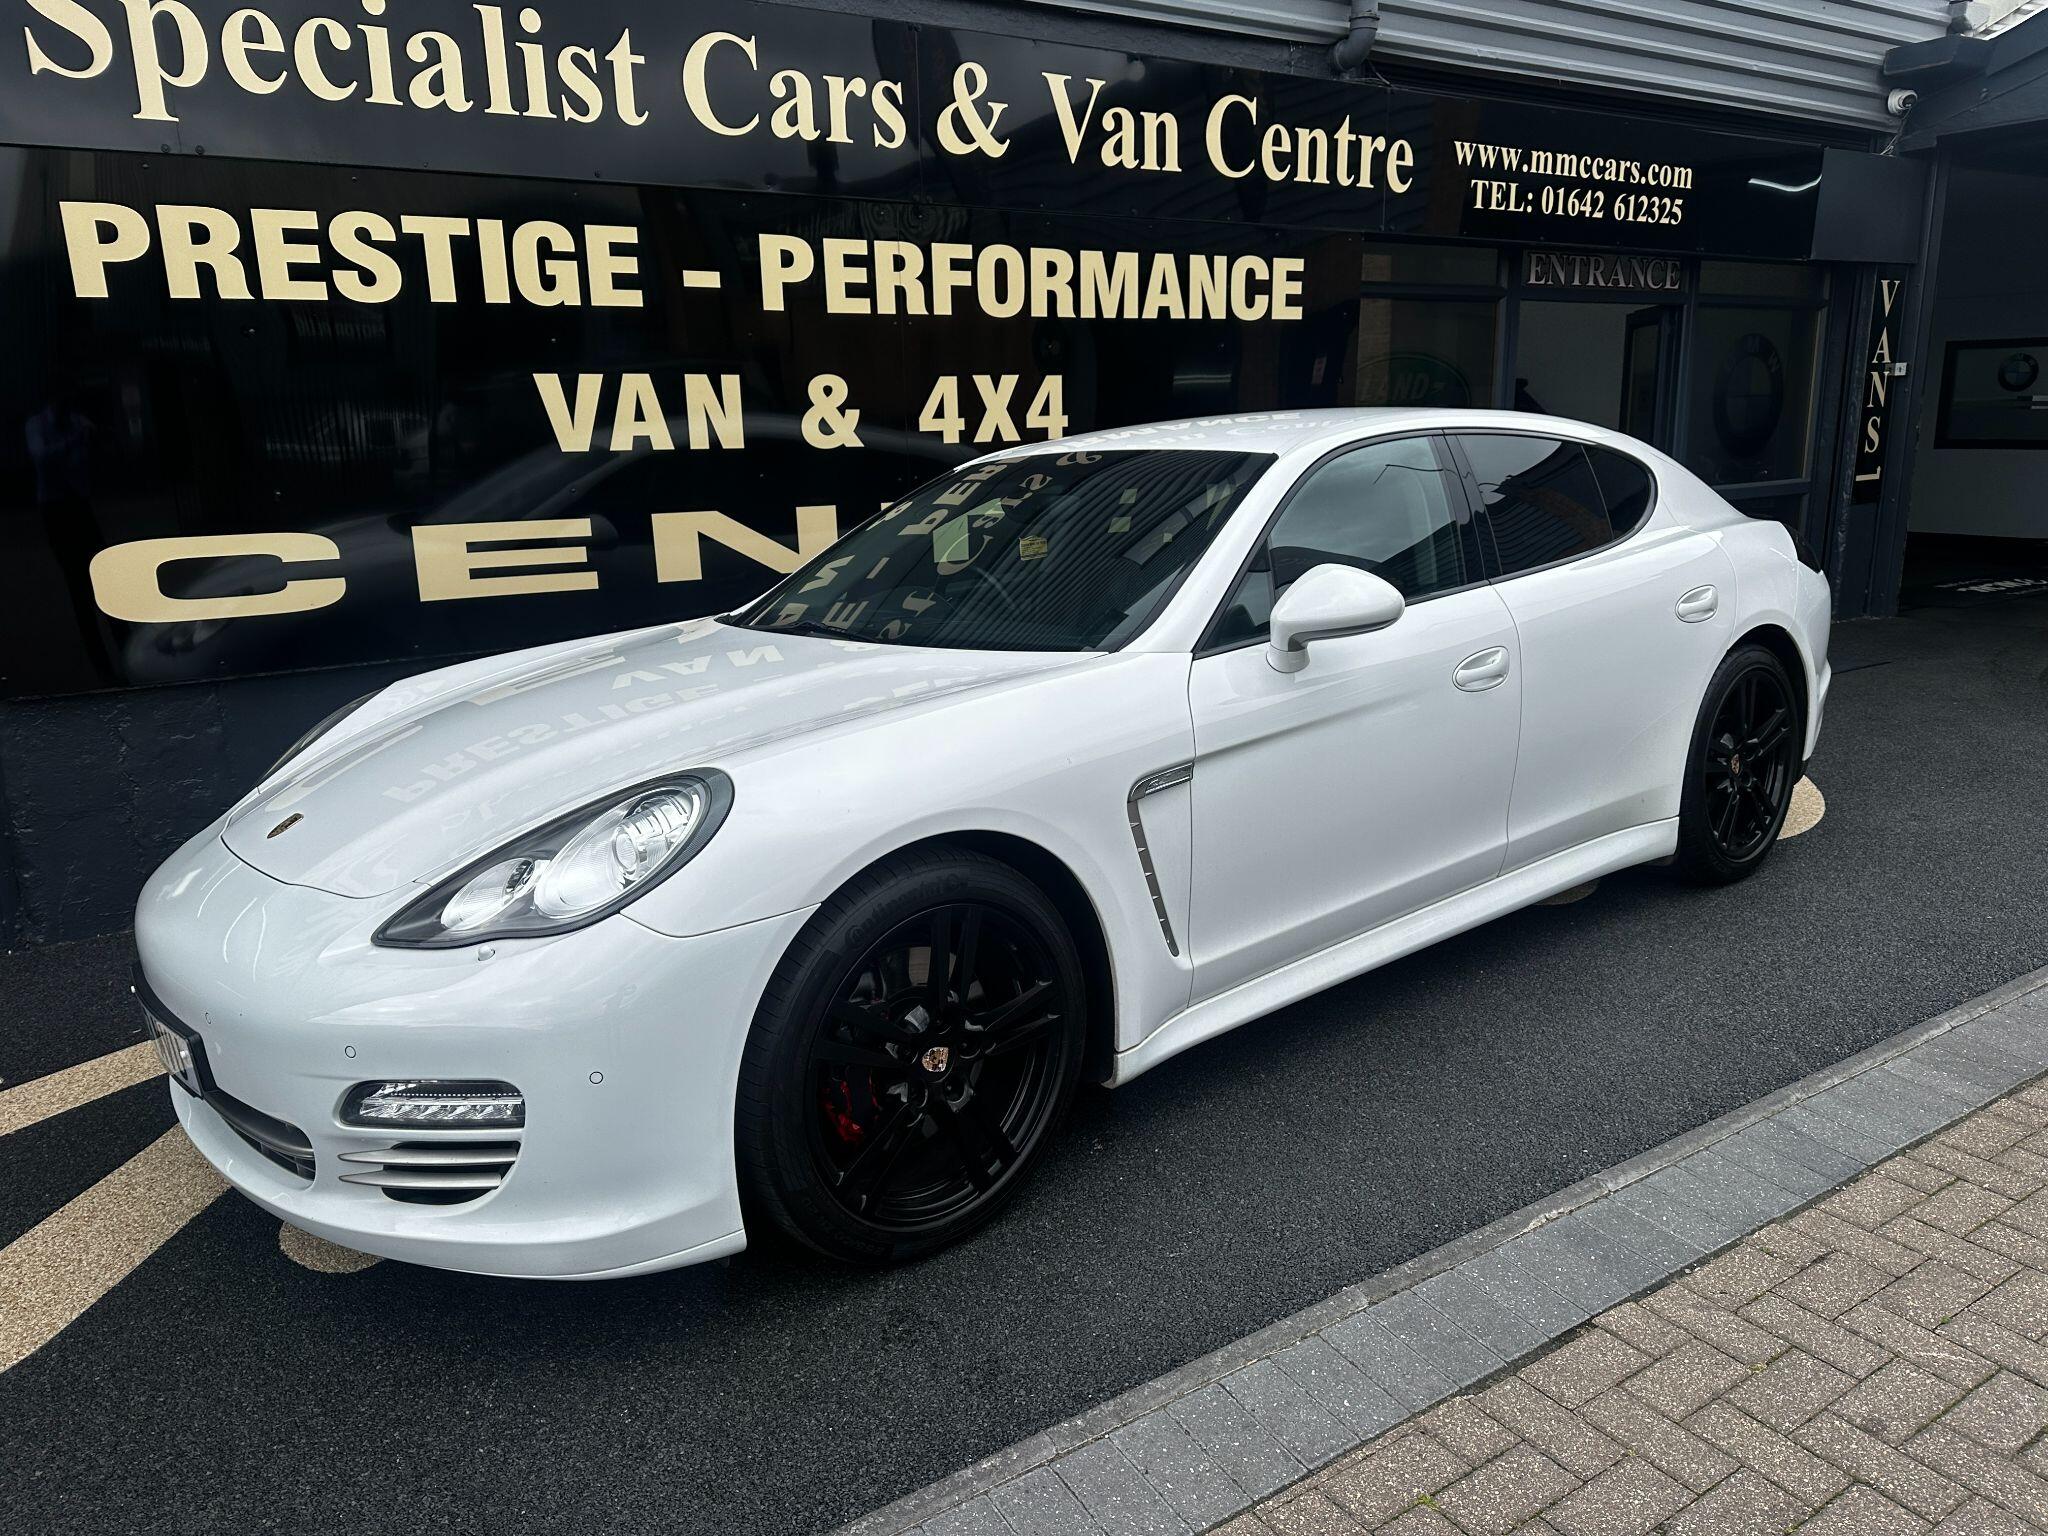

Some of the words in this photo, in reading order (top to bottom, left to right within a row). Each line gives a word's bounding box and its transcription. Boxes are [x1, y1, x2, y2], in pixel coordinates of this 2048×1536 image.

[24, 0, 650, 126] Specialist
[682, 31, 907, 149] Cars
[936, 61, 1011, 158] &
[1041, 71, 1182, 173] Van
[1205, 94, 1414, 194] Centre
[1453, 140, 1693, 189] www.mmccars.com
[1471, 179, 1533, 213] TEL:
[1541, 185, 1605, 219] 01642
[1613, 193, 1684, 226] 612325
[59, 201, 644, 307] PRESTIGE
[758, 233, 1305, 321] PERFORMANCE
[1527, 253, 1682, 291] ENTRANCE
[532, 373, 745, 453] VAN
[800, 373, 865, 450] &
[918, 374, 1069, 443] 4X4
[1863, 279, 1901, 454] VANS
[89, 503, 893, 622] CEN
